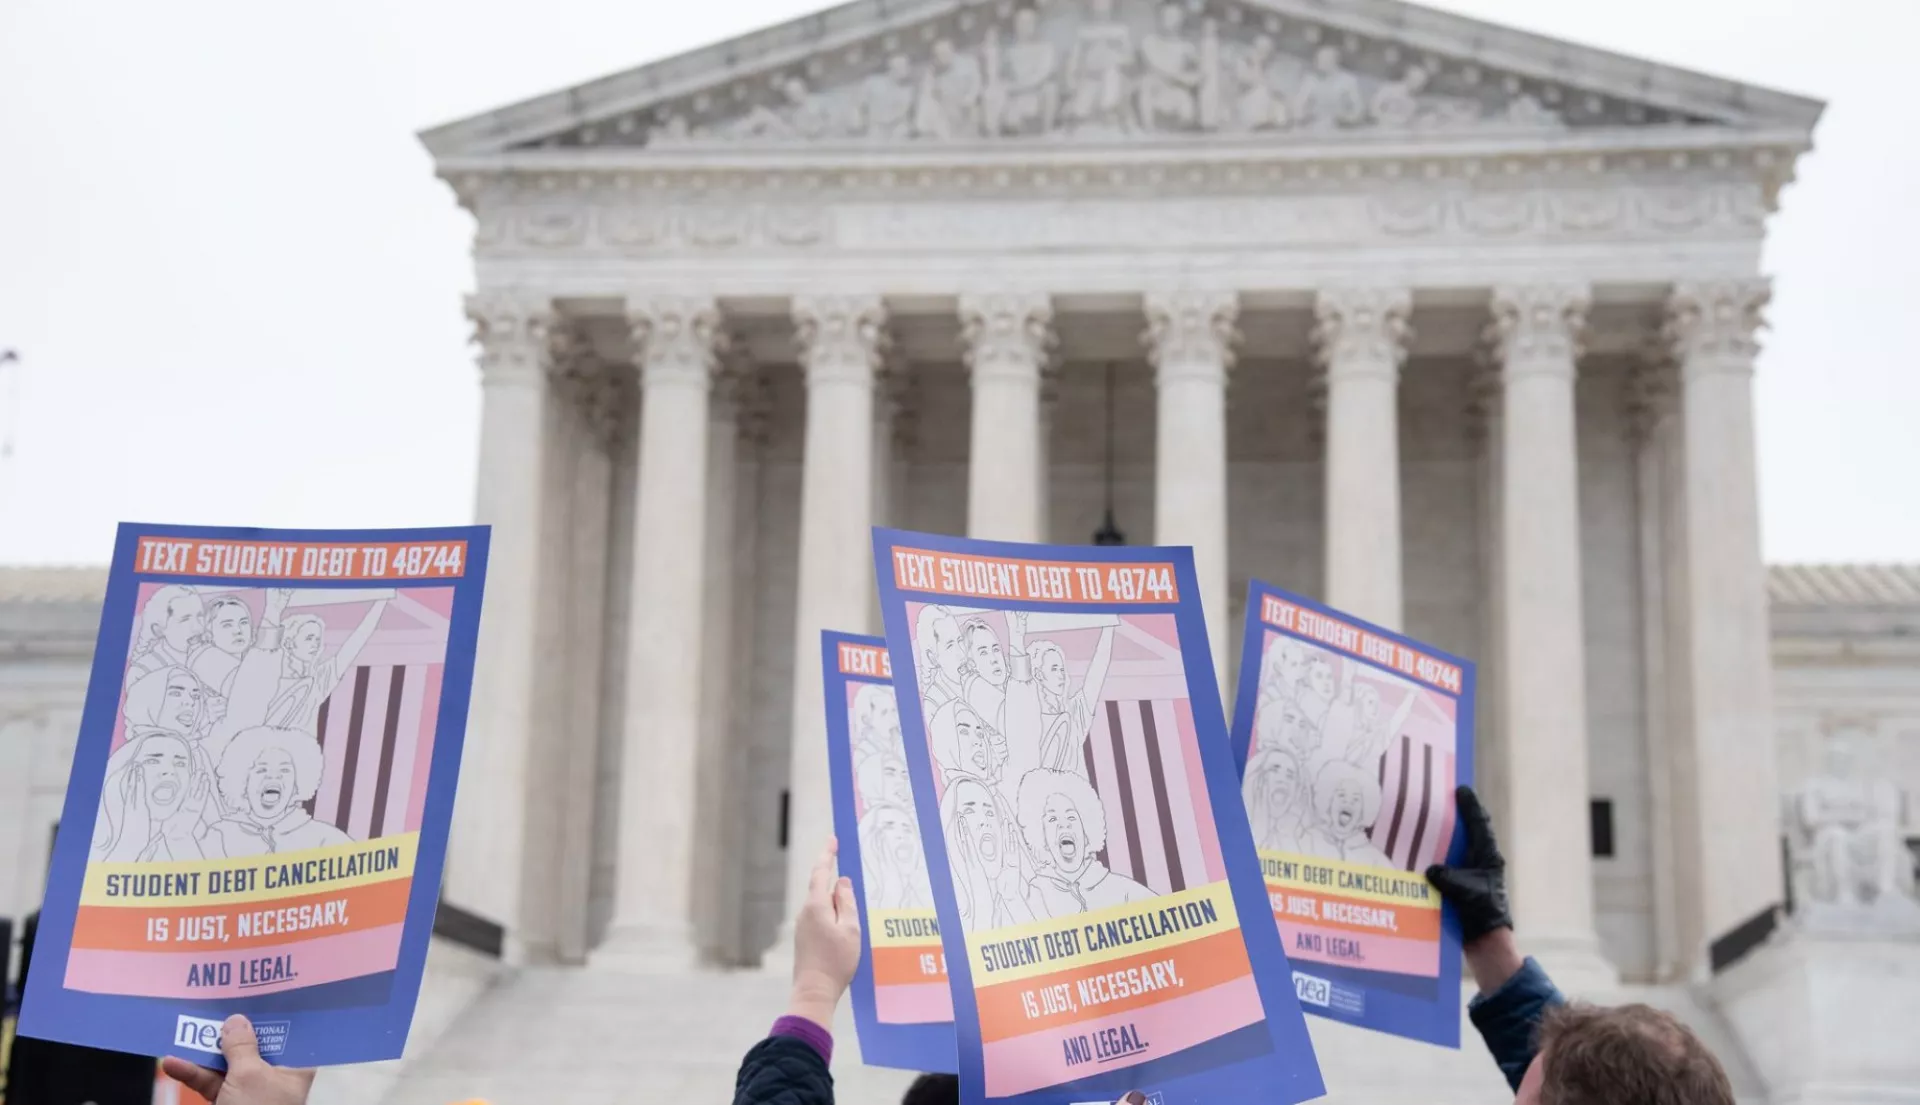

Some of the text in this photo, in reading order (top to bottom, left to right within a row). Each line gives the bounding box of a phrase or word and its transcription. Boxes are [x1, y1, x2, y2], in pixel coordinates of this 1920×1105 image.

[141, 541, 461, 577] TEXT STUDENT DEBT TO 48744
[896, 552, 1173, 600] TEXT STUDENT DEBT TO 48744
[840, 646, 877, 674] TEXT
[1264, 598, 1460, 692] TEXT STUDENT DEBT TO 48744
[106, 847, 399, 897] STUDENT DEBT CANCELLATION
[1260, 858, 1429, 899] UDENT DEBT CANCELLATION
[147, 899, 349, 943] IS JUST, NECESSARY,
[884, 918, 940, 938] STUDEN
[1286, 895, 1320, 921] JUST,
[1322, 900, 1398, 932] NECESSARY,
[980, 936, 1043, 972] STUDENT
[1043, 928, 1082, 960] DEBT
[1084, 898, 1218, 951] CANCELLATION
[1296, 932, 1365, 960] AND LEGAL.
[186, 955, 298, 987] AND LEGAL.
[919, 953, 938, 975] IS
[1021, 959, 1184, 1019] IS JUST, NECESSARY,
[1295, 977, 1326, 1002] nea
[255, 1026, 286, 1034] TIONAL
[1063, 1023, 1150, 1067] AND LEGAL.
